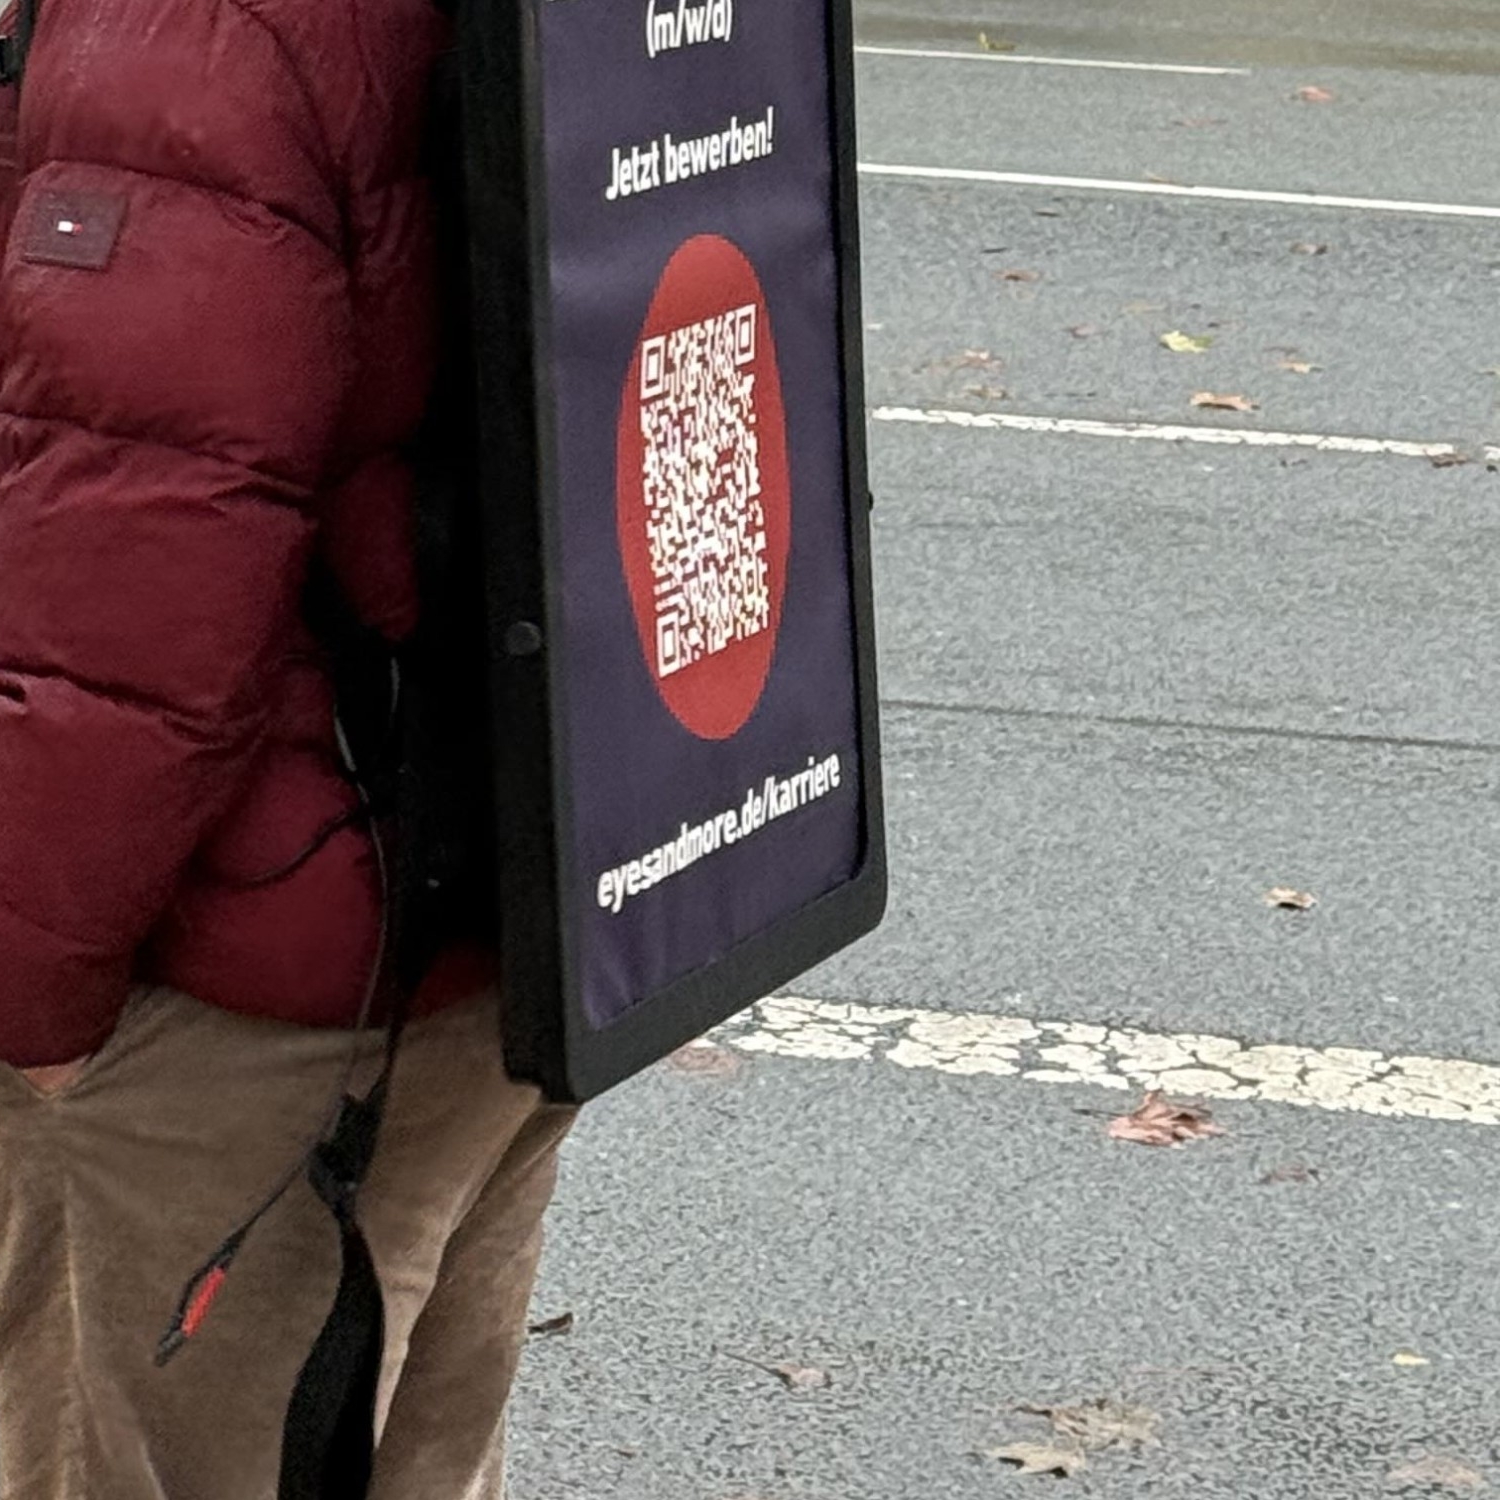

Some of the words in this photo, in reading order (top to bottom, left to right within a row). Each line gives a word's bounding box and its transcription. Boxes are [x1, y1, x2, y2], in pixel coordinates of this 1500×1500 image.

[605, 140, 660, 200] Jetzt
[664, 105, 773, 184] bewerben!
[597, 753, 840, 913] eyesandmore.de/karriere
